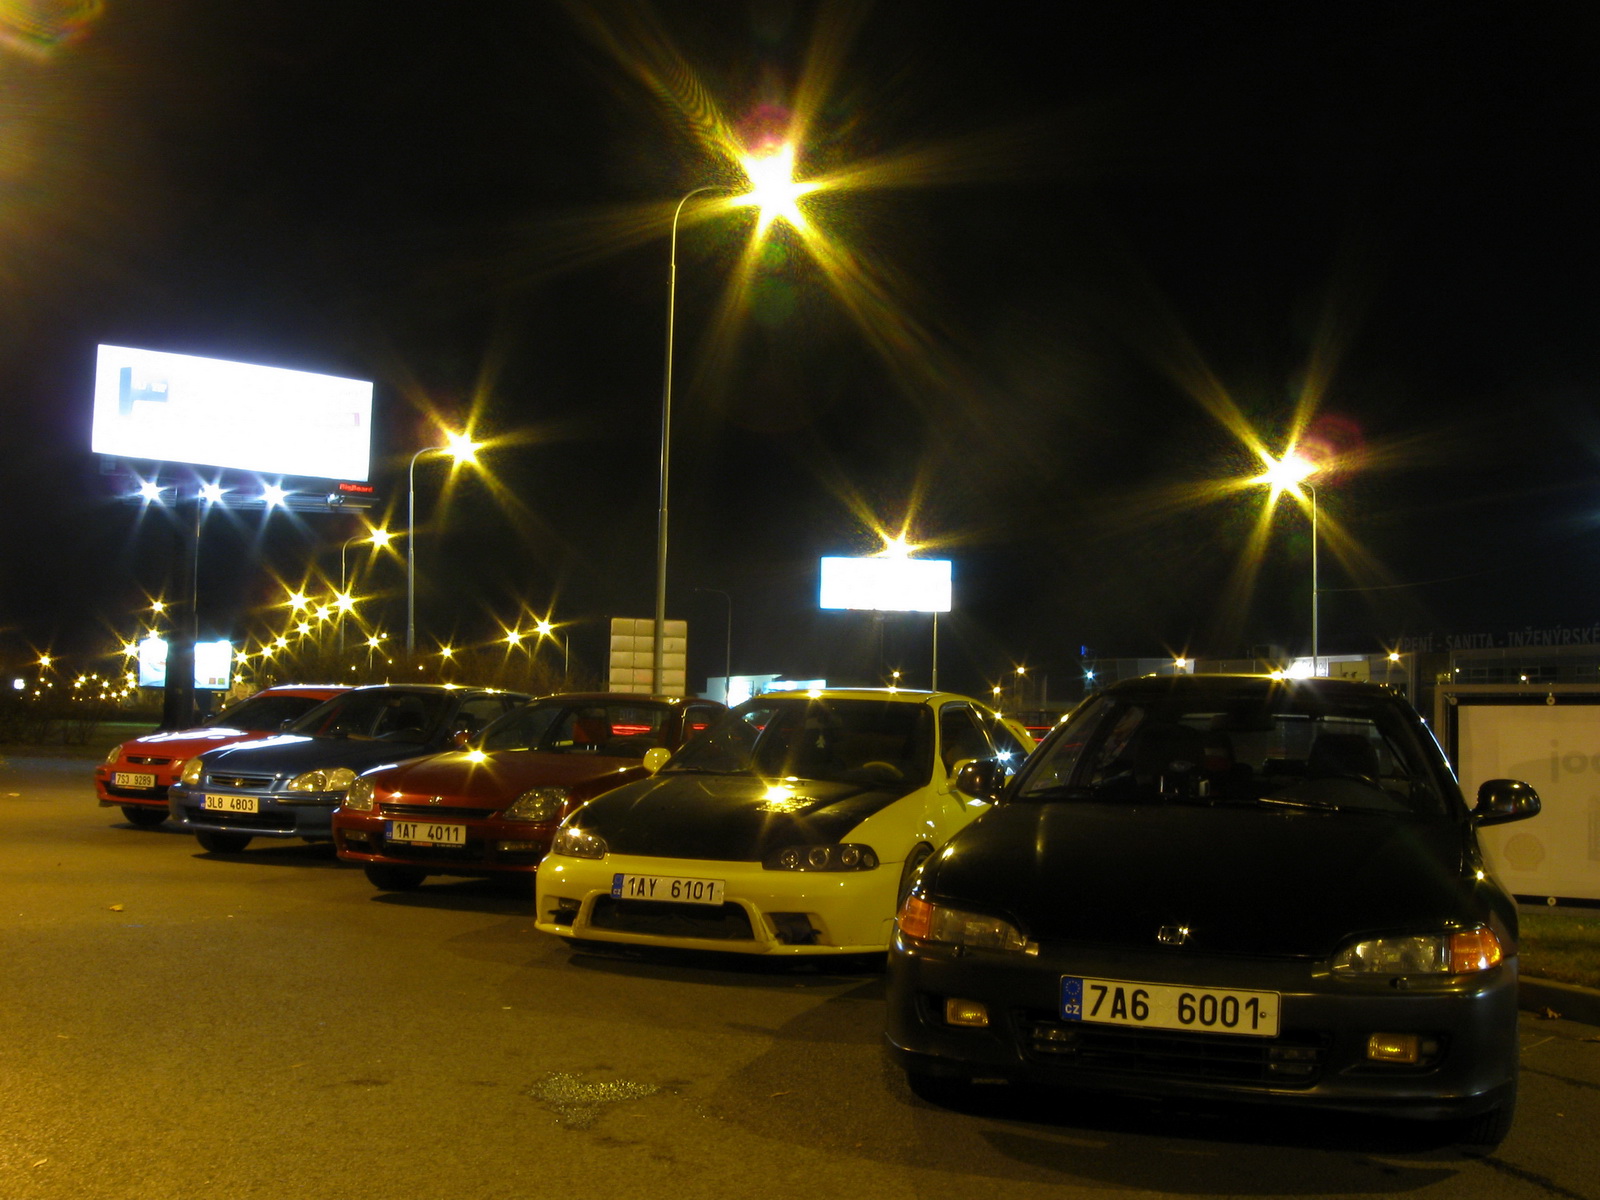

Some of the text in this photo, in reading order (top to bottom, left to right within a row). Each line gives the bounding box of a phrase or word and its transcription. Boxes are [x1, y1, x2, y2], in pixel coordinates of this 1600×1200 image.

[1445, 633, 1494, 652] SANITA
[116, 773, 151, 786] 7S3 9289
[207, 796, 223, 809] 3L8
[229, 798, 254, 811] 4803
[396, 823, 418, 839] 1AT
[427, 825, 459, 842] 4011
[628, 877, 658, 897] 1AY
[670, 880, 715, 901] 6101
[1064, 984, 1261, 1030] CZ 7A6 6001
